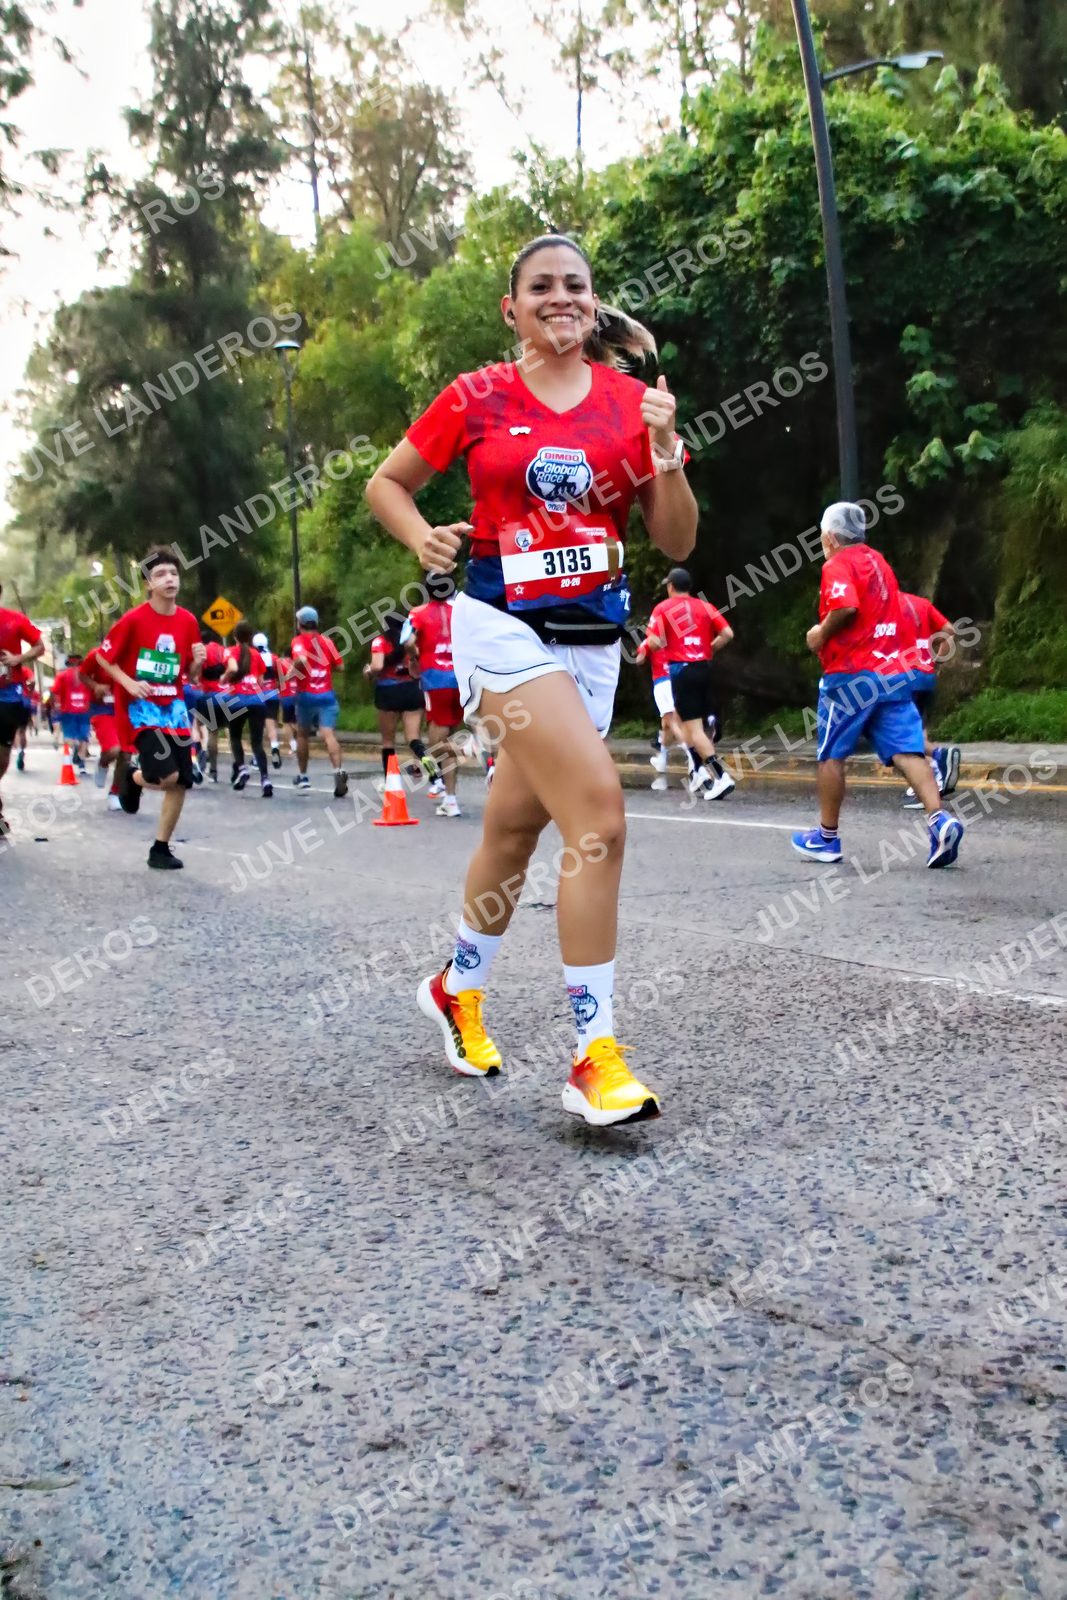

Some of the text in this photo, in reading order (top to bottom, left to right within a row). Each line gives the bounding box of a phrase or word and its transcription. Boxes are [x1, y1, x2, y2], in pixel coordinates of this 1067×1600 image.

[544, 452, 580, 462] BIMBO
[543, 463, 578, 476] Global
[536, 471, 564, 483] Race
[543, 547, 592, 576] 3135
